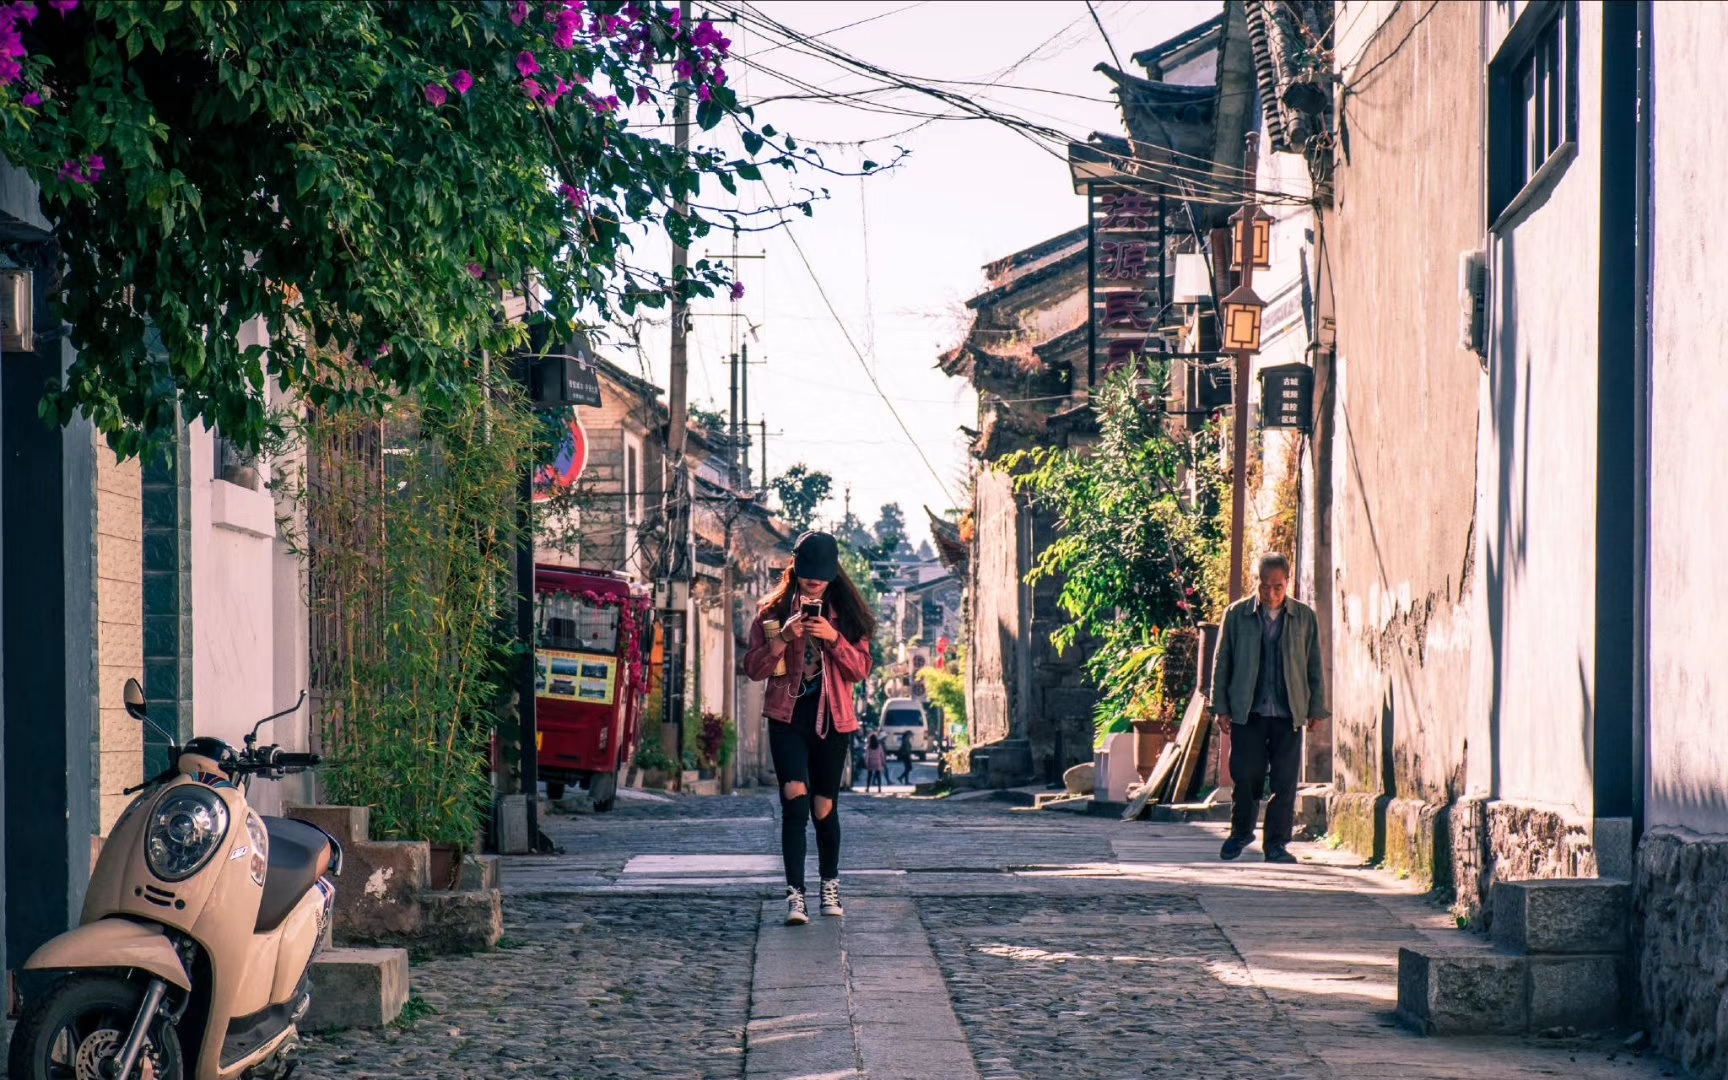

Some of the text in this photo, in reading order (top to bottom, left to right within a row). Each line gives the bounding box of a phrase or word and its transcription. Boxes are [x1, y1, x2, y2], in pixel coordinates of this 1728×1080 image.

[1282, 377, 1299, 386] 古城
[1282, 390, 1299, 399] 视频
[1281, 403, 1298, 412] 监控
[1281, 415, 1297, 424] 区域
